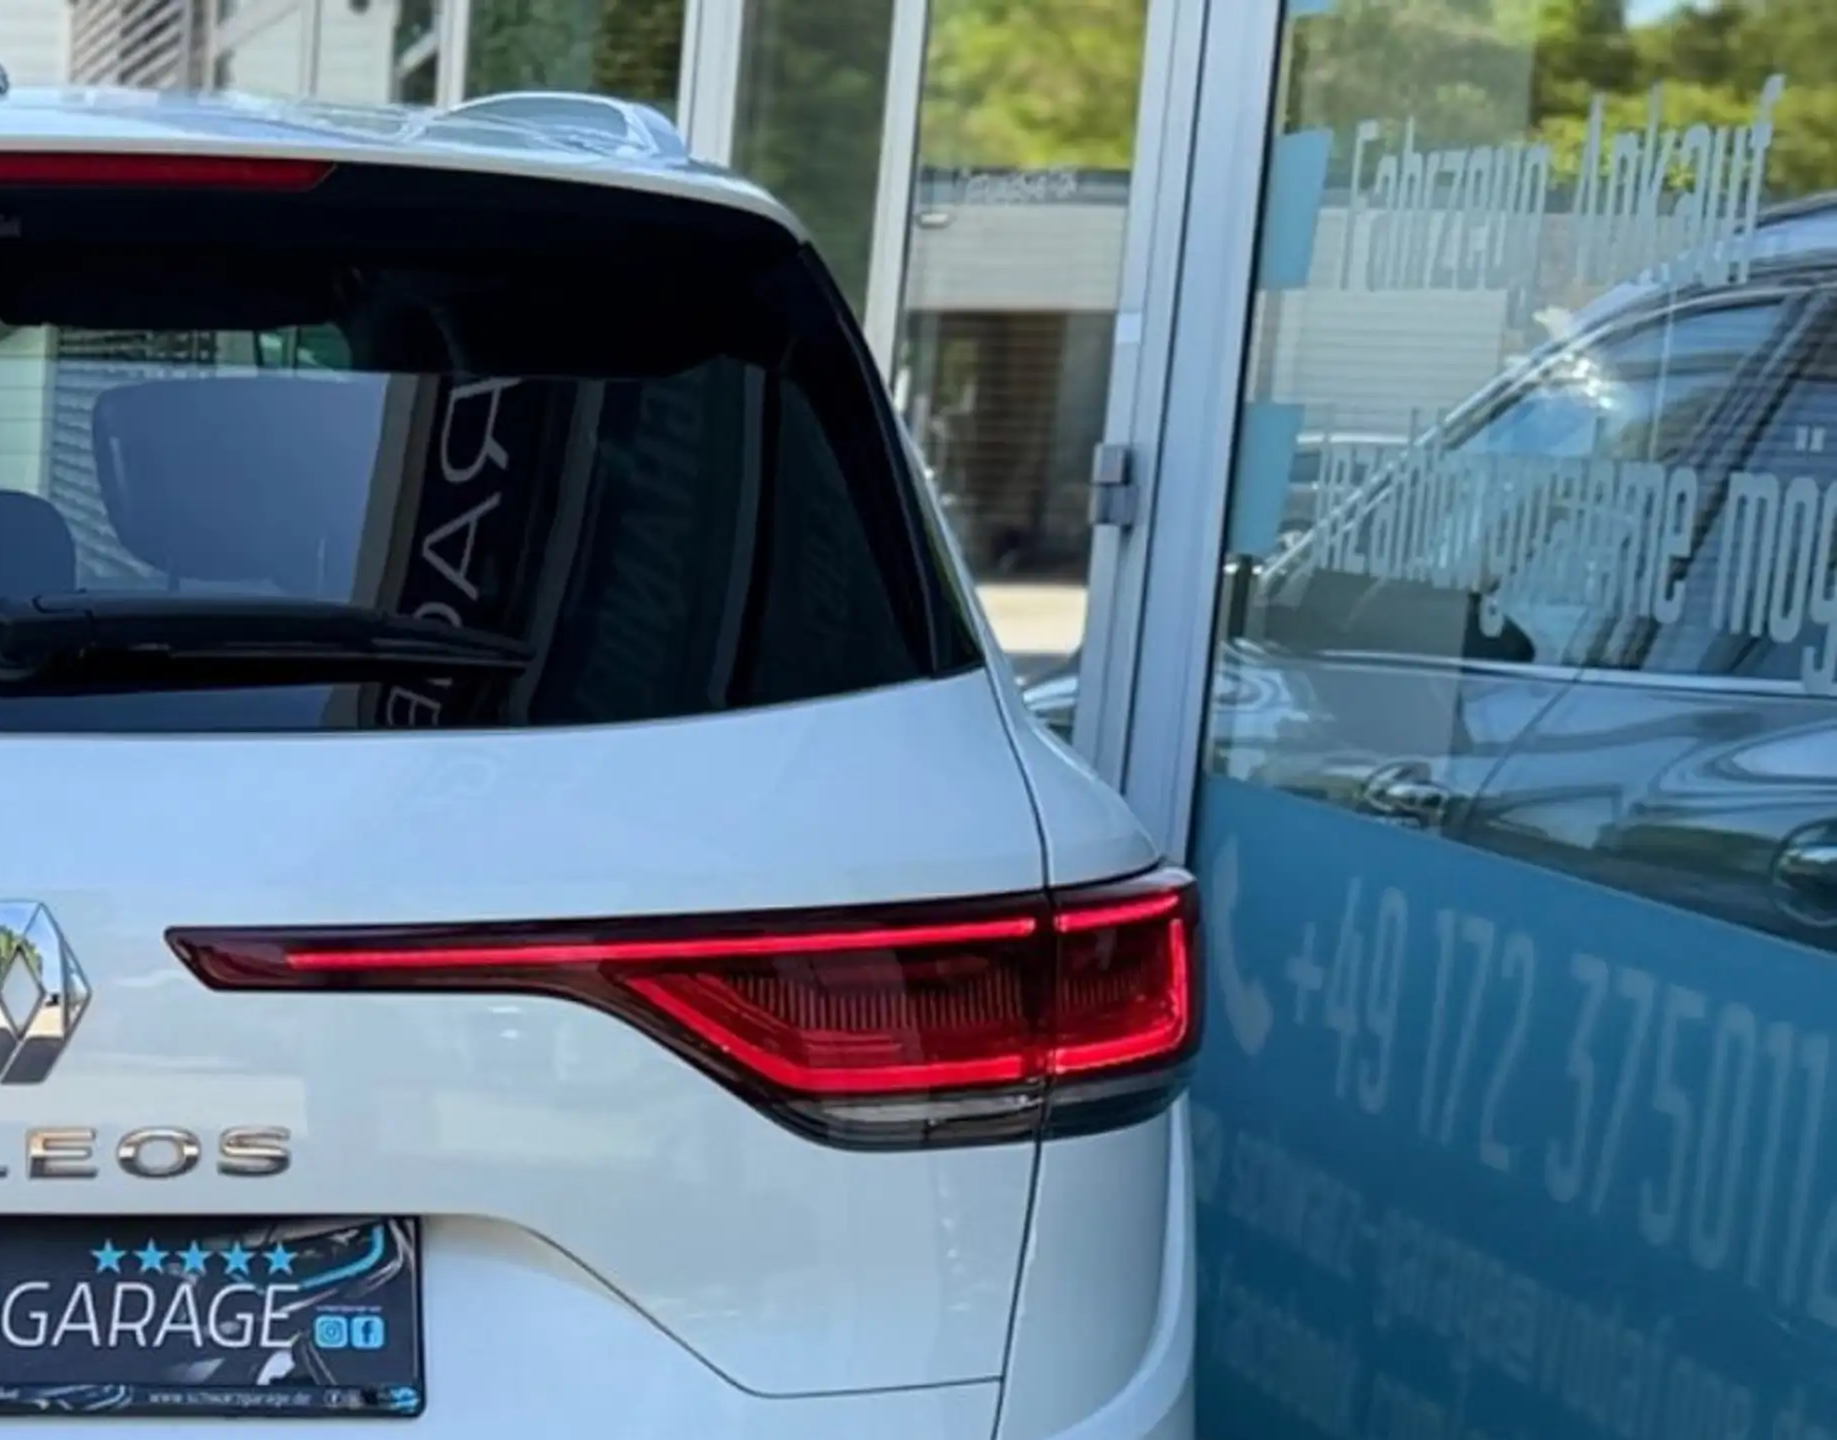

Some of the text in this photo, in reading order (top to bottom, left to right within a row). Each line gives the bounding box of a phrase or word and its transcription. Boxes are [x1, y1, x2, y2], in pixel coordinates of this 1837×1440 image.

[1572, 73, 1786, 286] Ankauf
[1284, 876, 1410, 1116] +49
[1418, 908, 1537, 1172] 172
